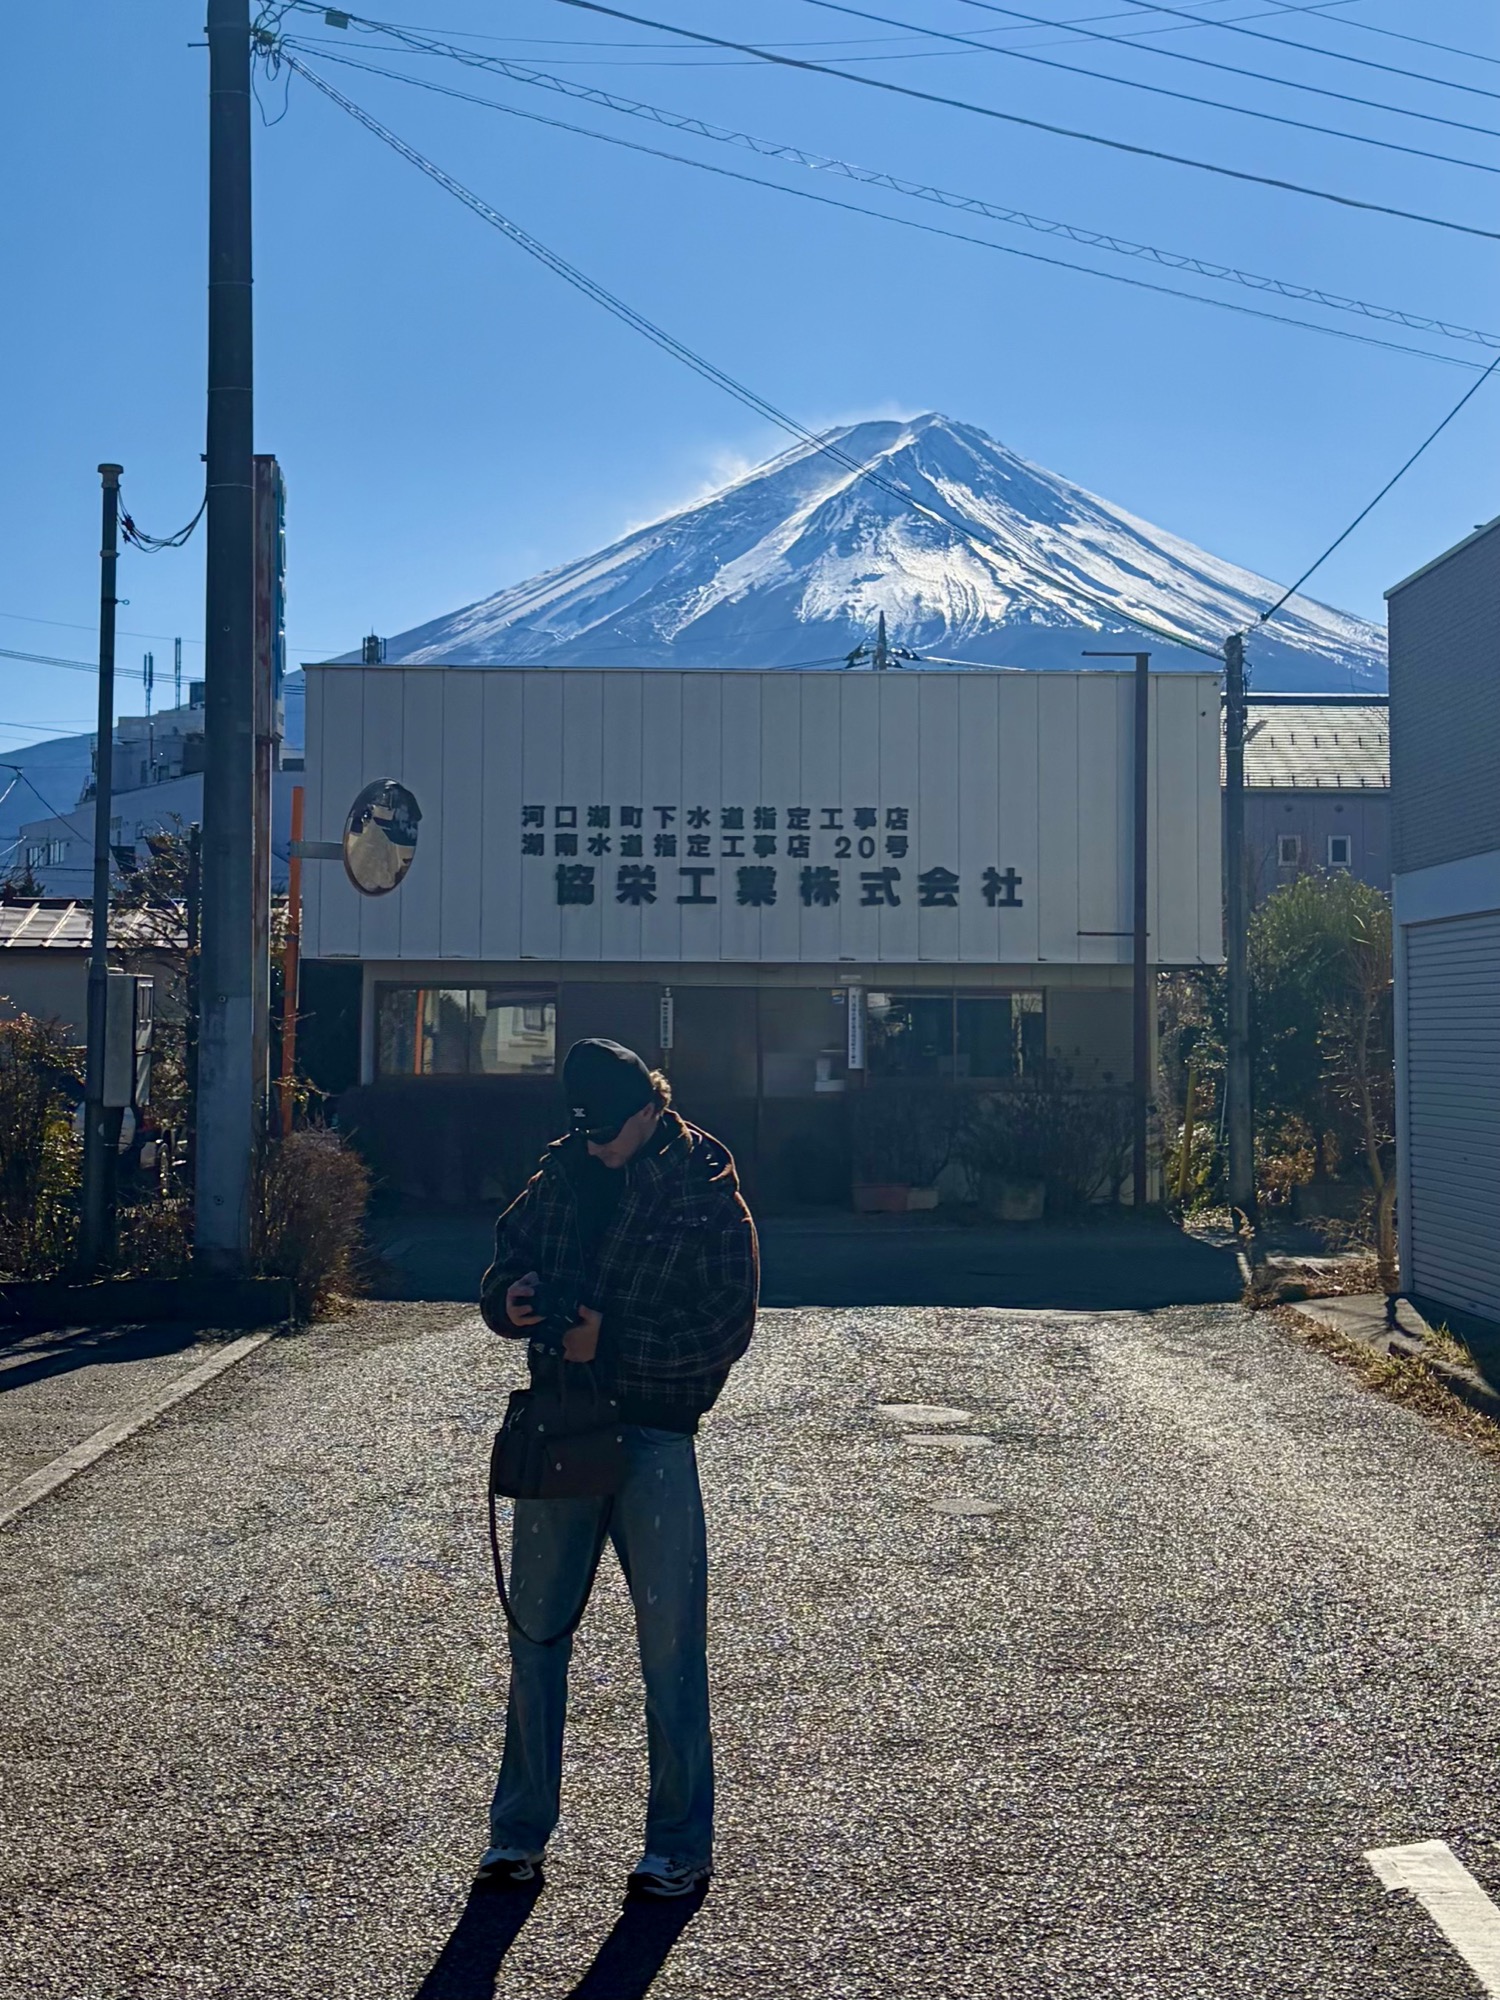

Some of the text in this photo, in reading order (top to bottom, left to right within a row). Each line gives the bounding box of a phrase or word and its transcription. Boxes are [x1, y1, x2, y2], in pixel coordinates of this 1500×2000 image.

[521, 805, 909, 830] 河口湖町下水道指定工事店
[556, 864, 1023, 907] 協栄工業株式会社
